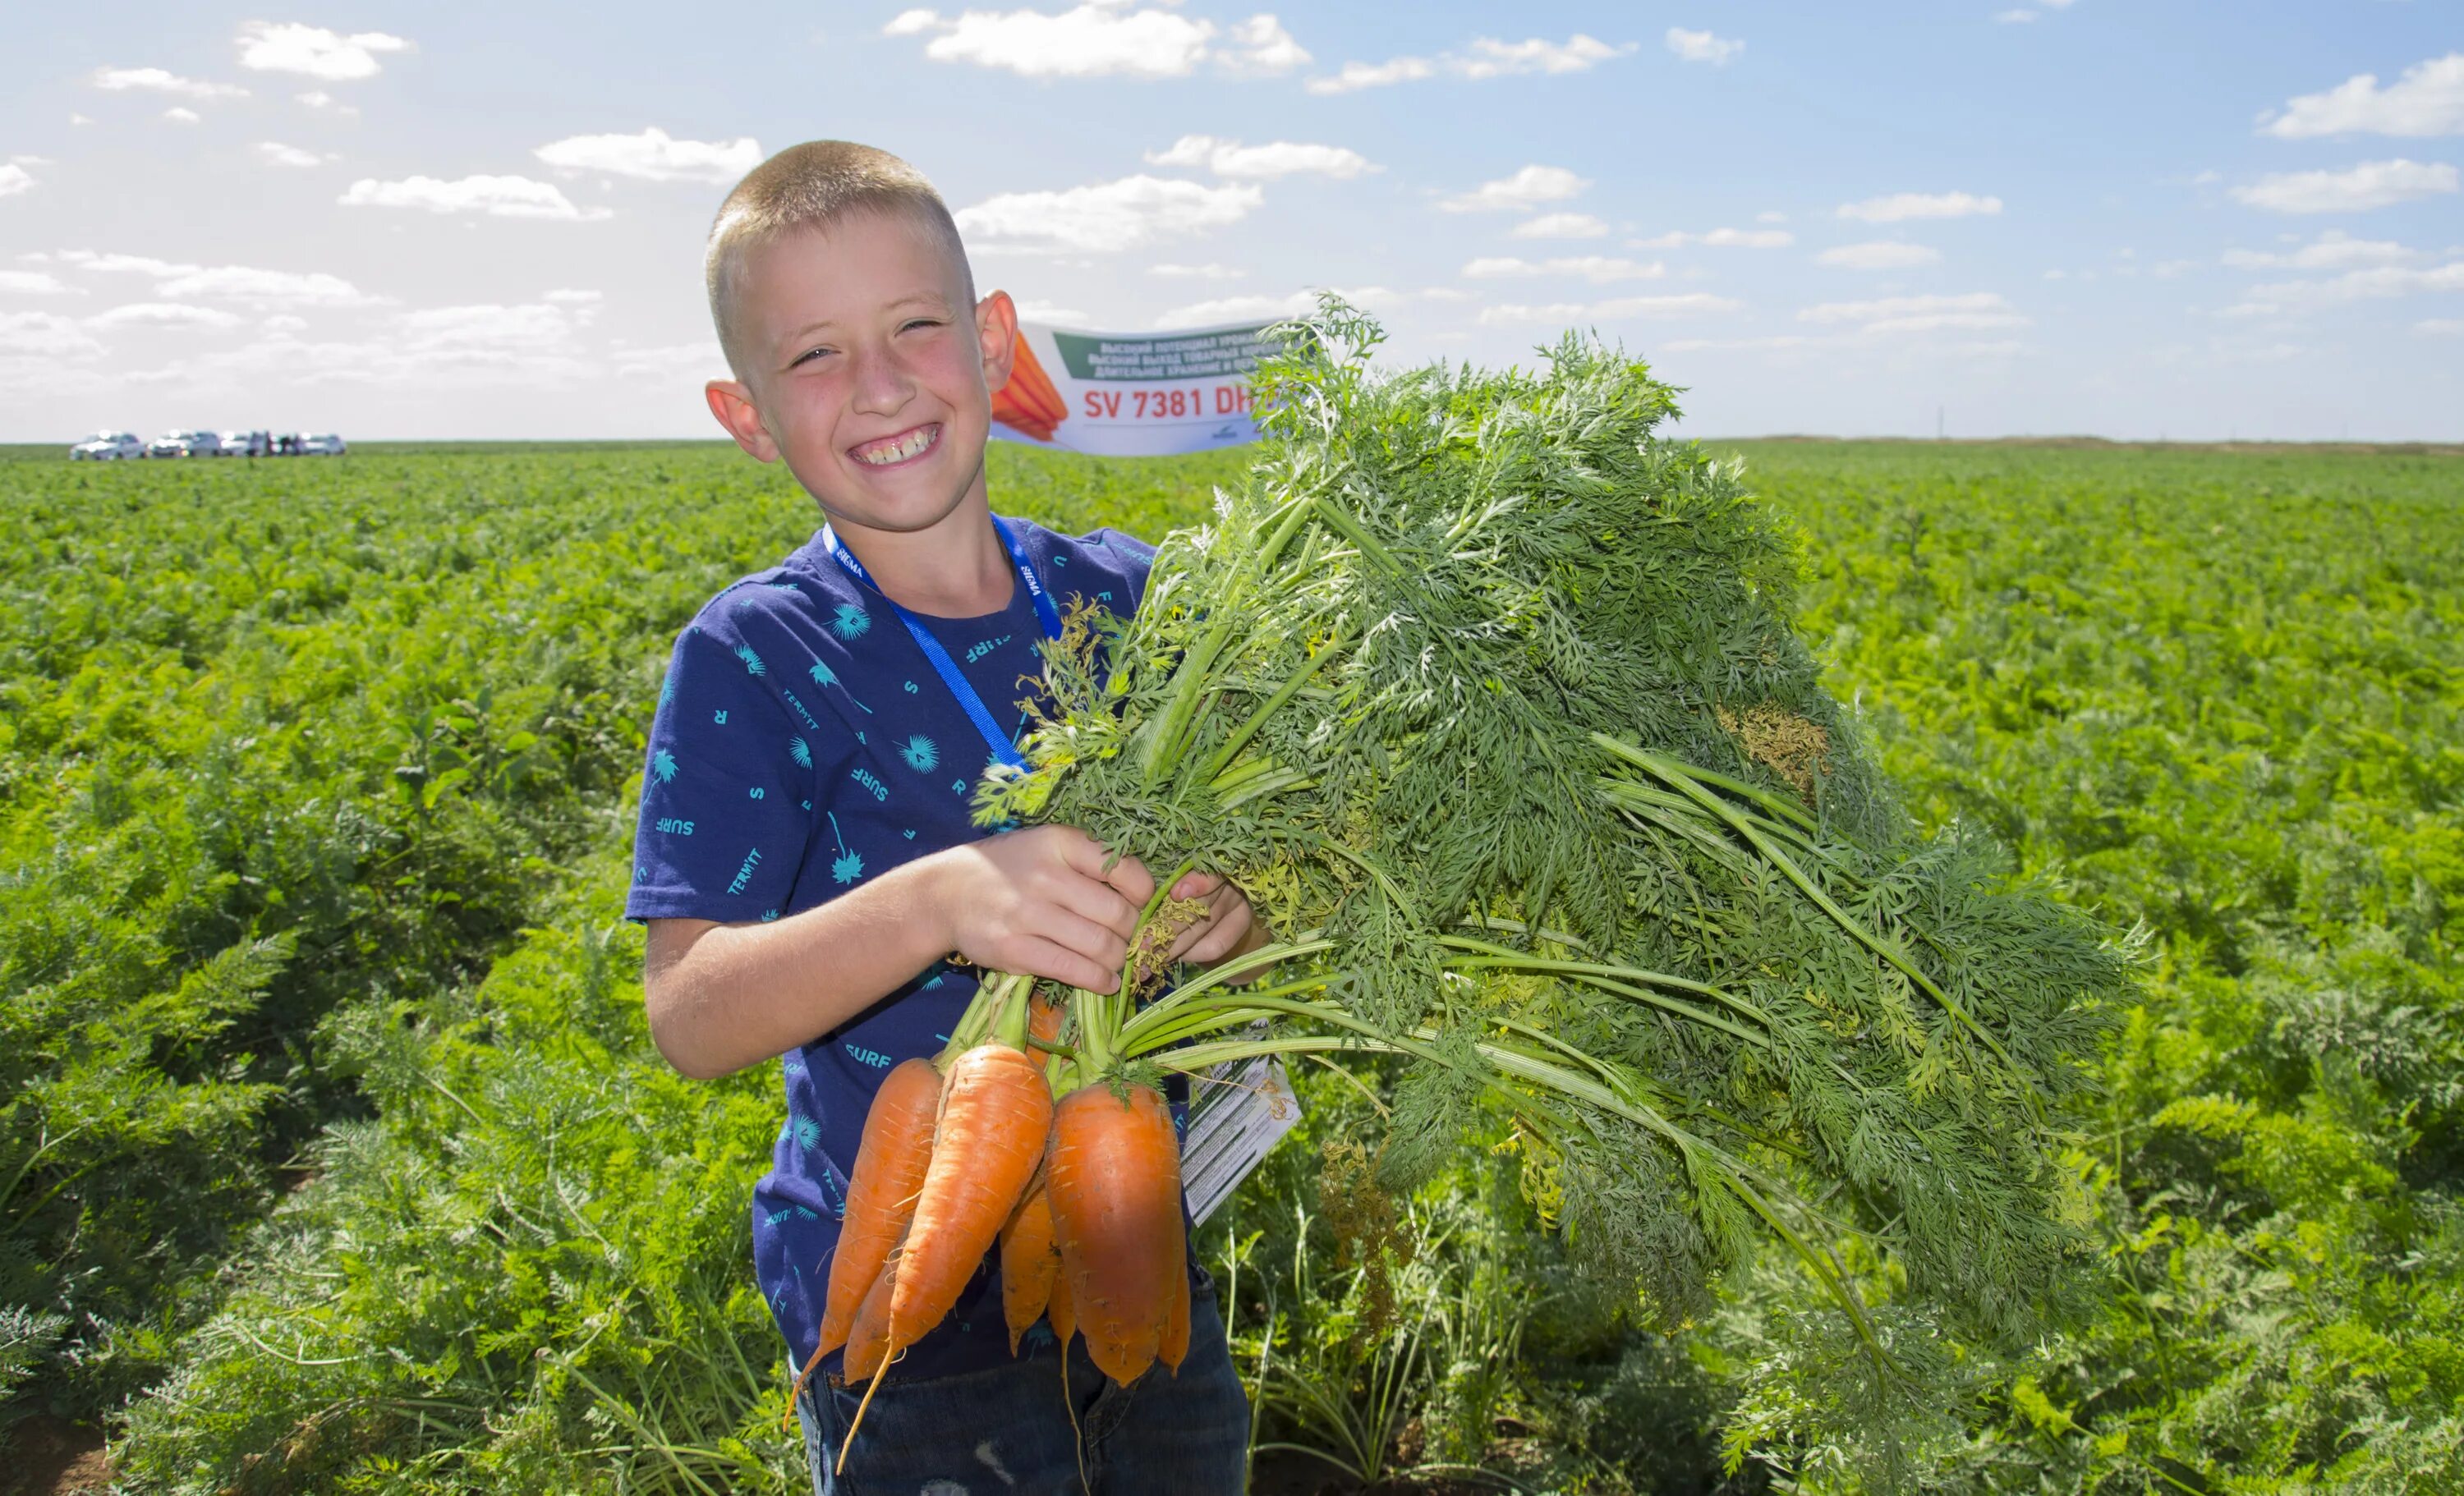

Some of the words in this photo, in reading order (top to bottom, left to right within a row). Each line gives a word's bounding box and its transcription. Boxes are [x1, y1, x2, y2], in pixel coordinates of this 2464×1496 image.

[1084, 390, 1121, 418] SV
[1133, 388, 1202, 418] 7381
[837, 548, 862, 578] SIGMA
[1021, 566, 1041, 596] SIGMA
[851, 768, 889, 802] SURF
[656, 818, 695, 836] SURF
[727, 847, 762, 895] TERMIT
[845, 1044, 891, 1068] SURF
